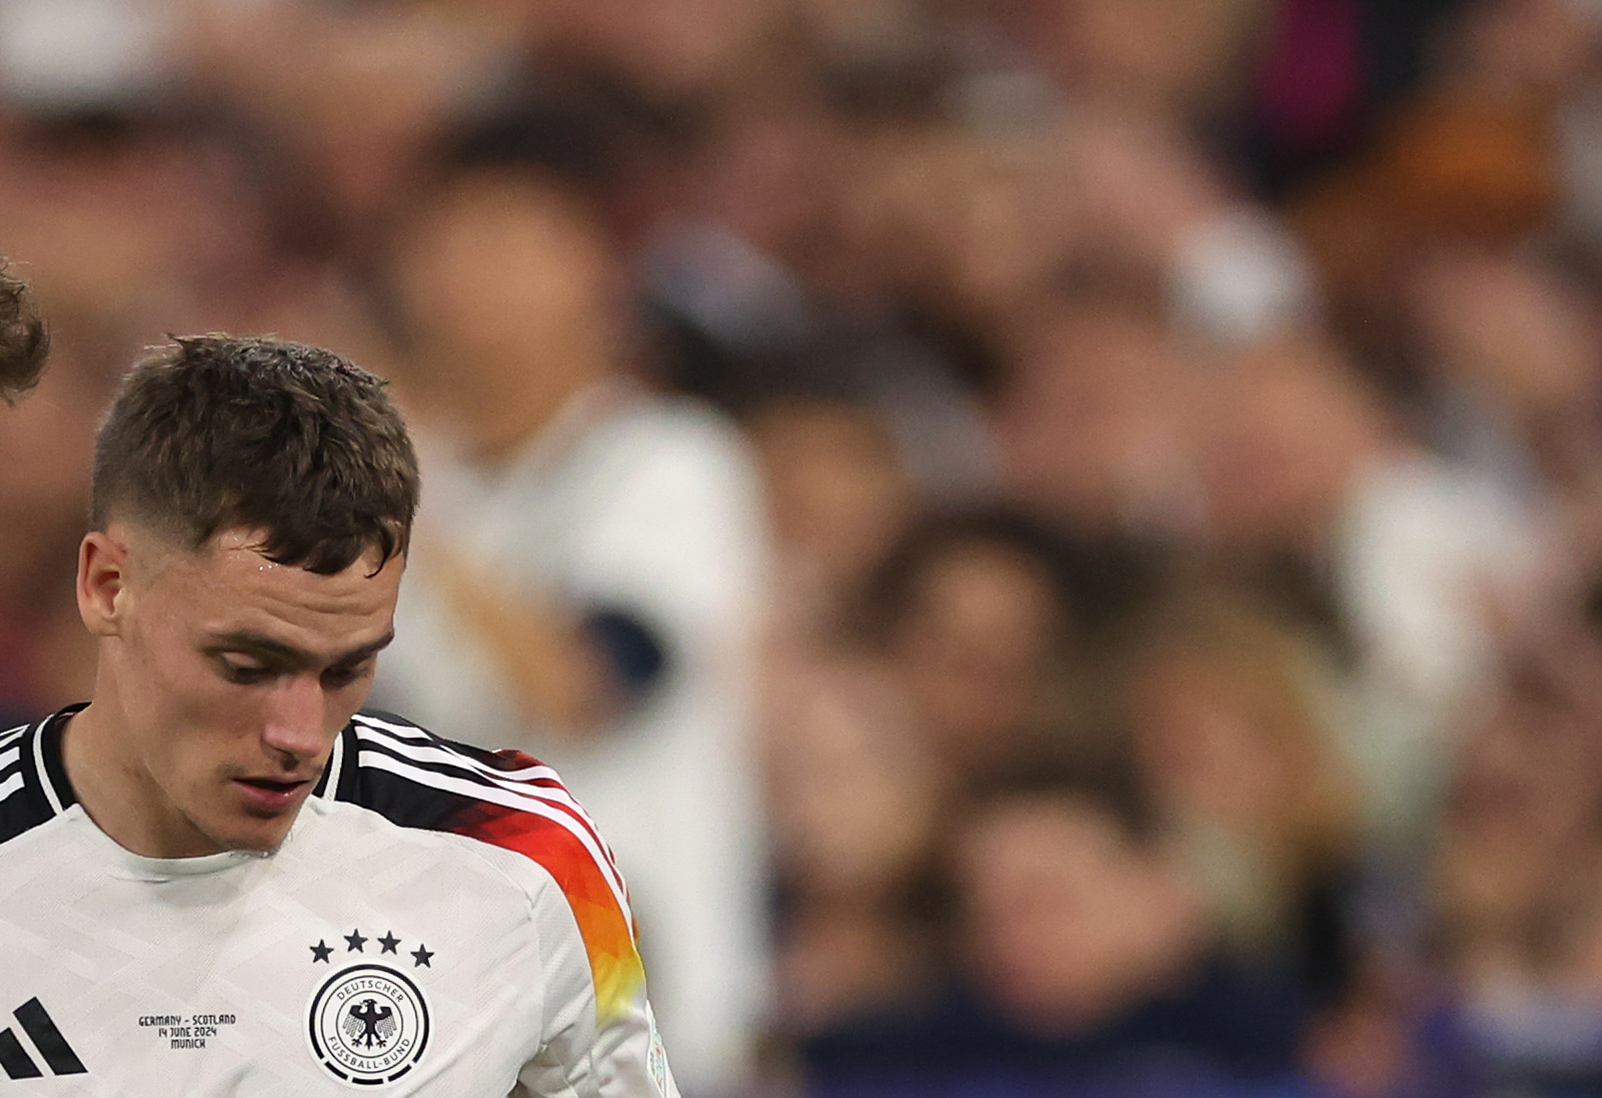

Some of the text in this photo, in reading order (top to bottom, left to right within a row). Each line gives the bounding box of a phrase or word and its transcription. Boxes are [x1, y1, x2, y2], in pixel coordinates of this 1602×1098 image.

[336, 979, 405, 1003] DEUTSCHER
[138, 1015, 182, 1027] GERMANY
[192, 1014, 236, 1026] SCOTLAND
[158, 1026, 217, 1038] 14 JUNE 2024
[170, 1038, 206, 1050] MUNICH
[327, 1036, 411, 1070] FUSSBALL-BUND
